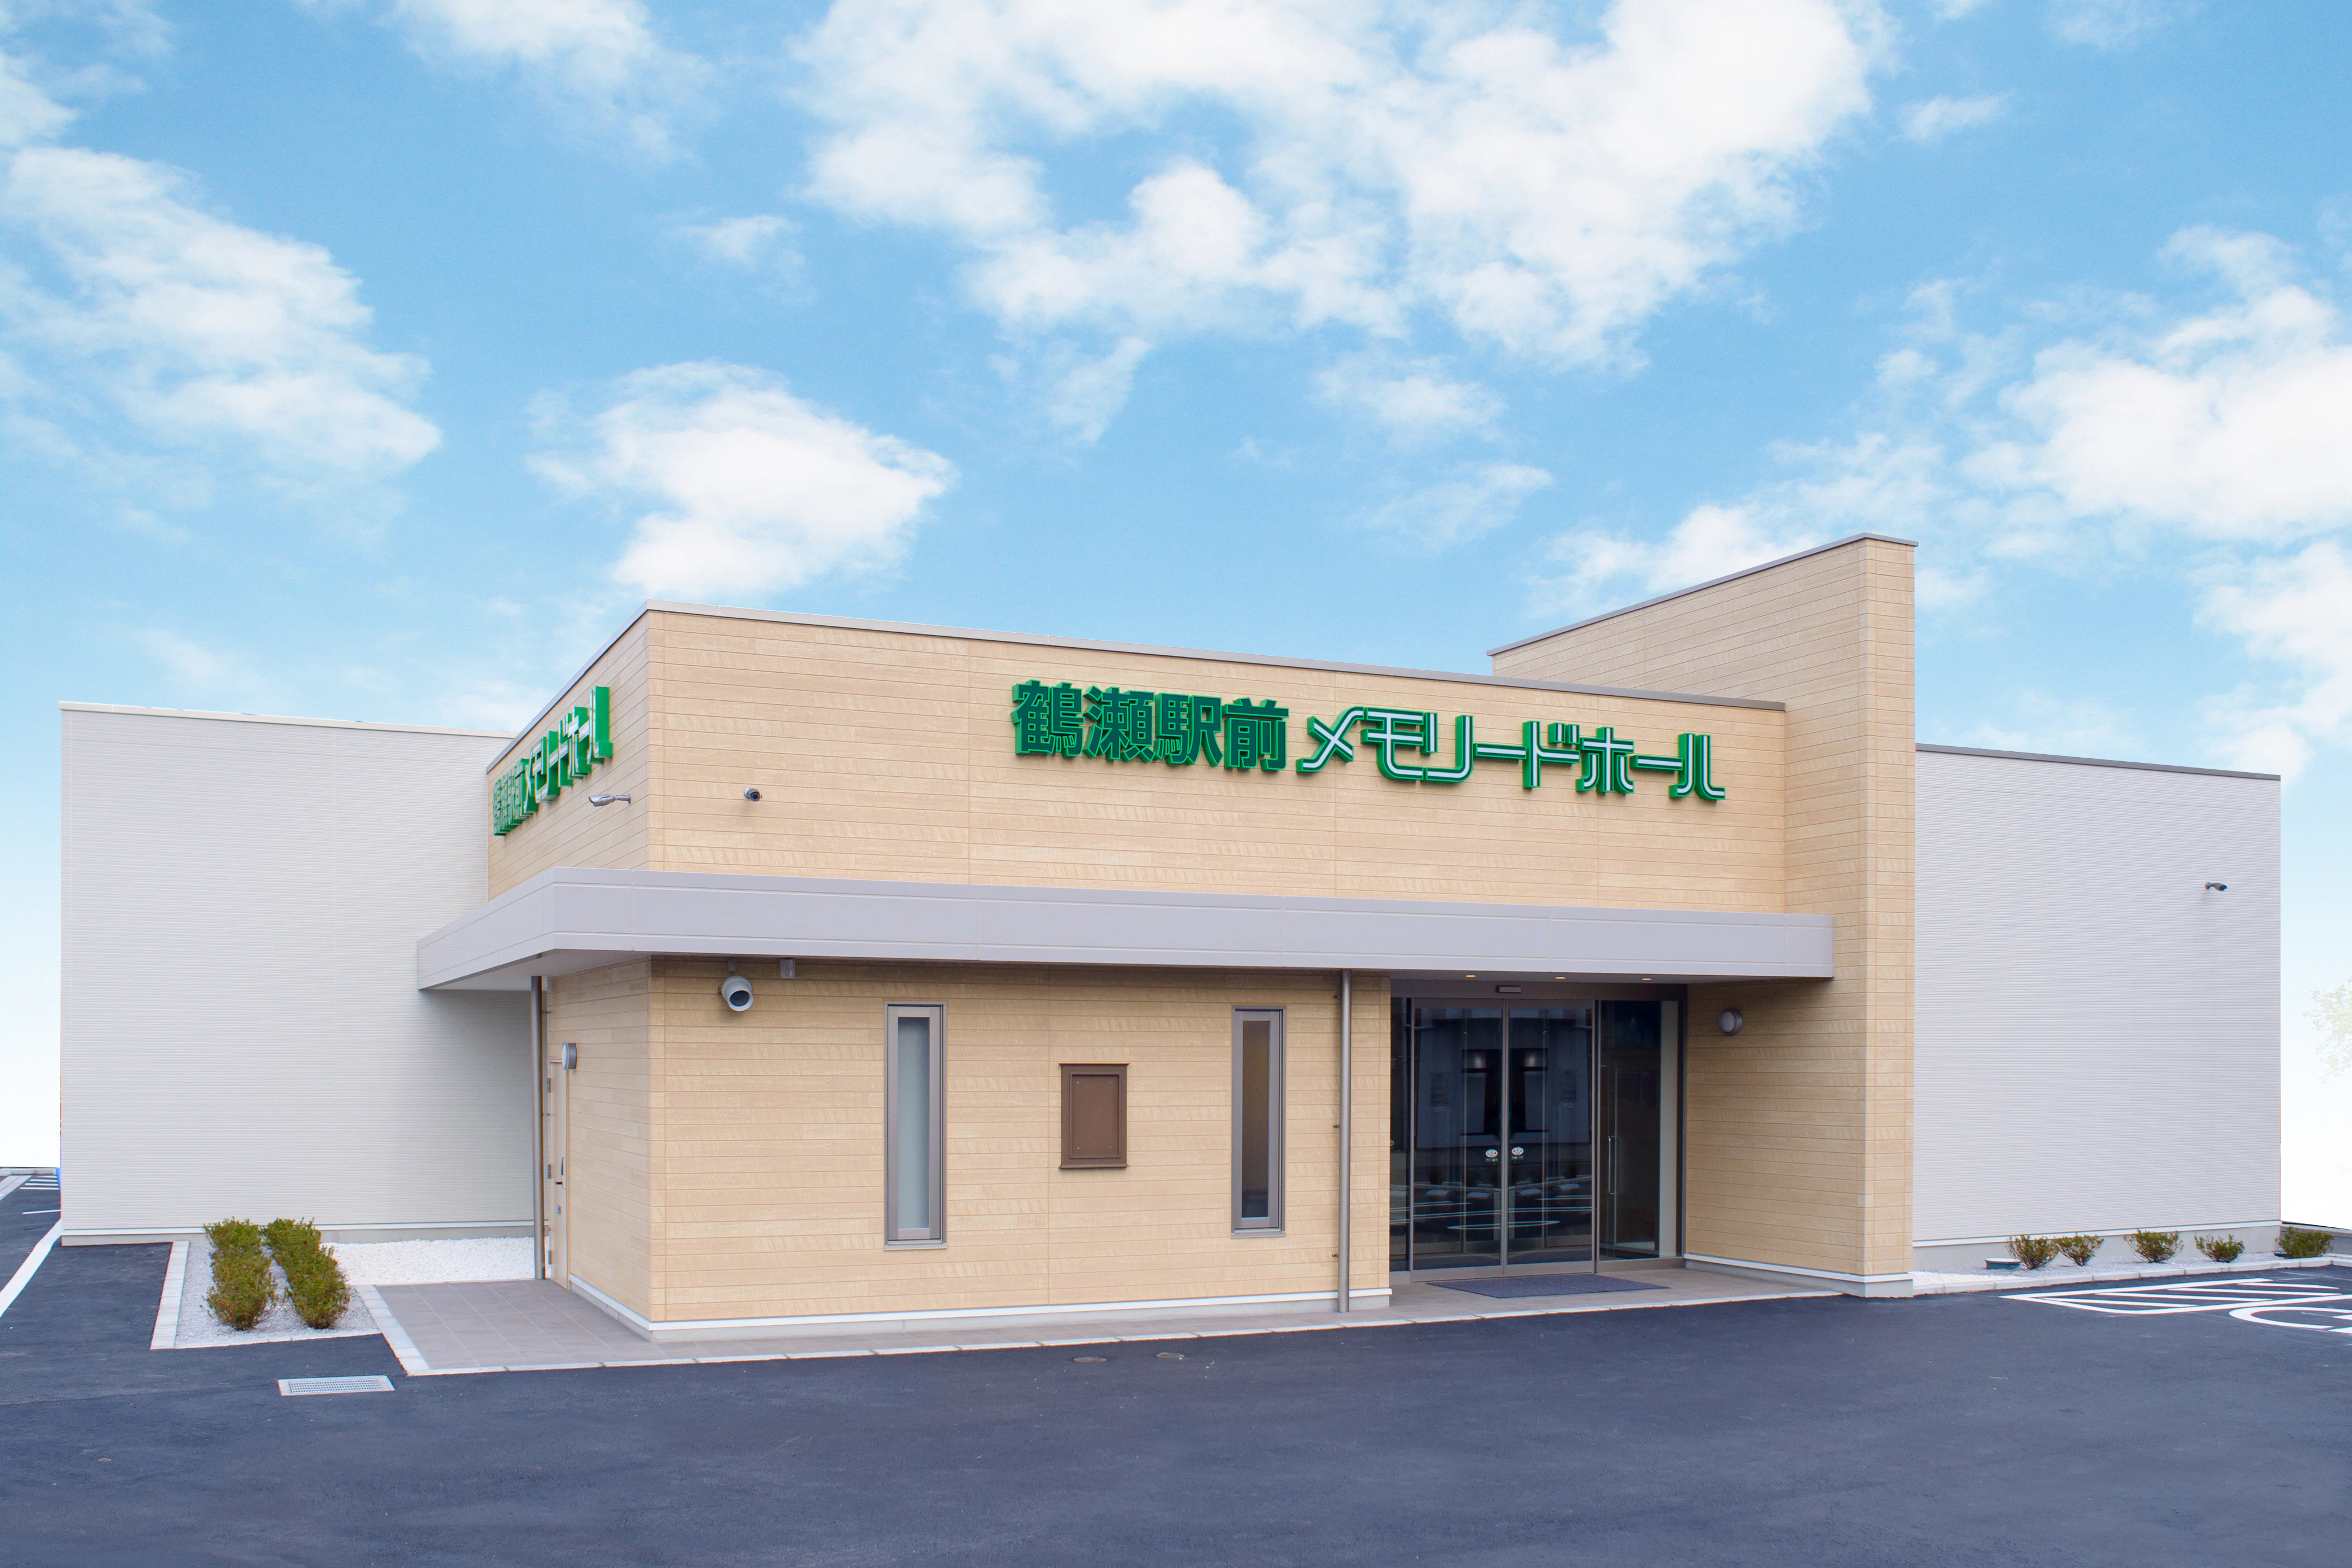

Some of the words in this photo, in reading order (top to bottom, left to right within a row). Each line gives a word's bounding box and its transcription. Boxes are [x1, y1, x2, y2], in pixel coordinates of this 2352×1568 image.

[1011, 680, 1726, 800] 鶴瀬駅前メモリードホール
